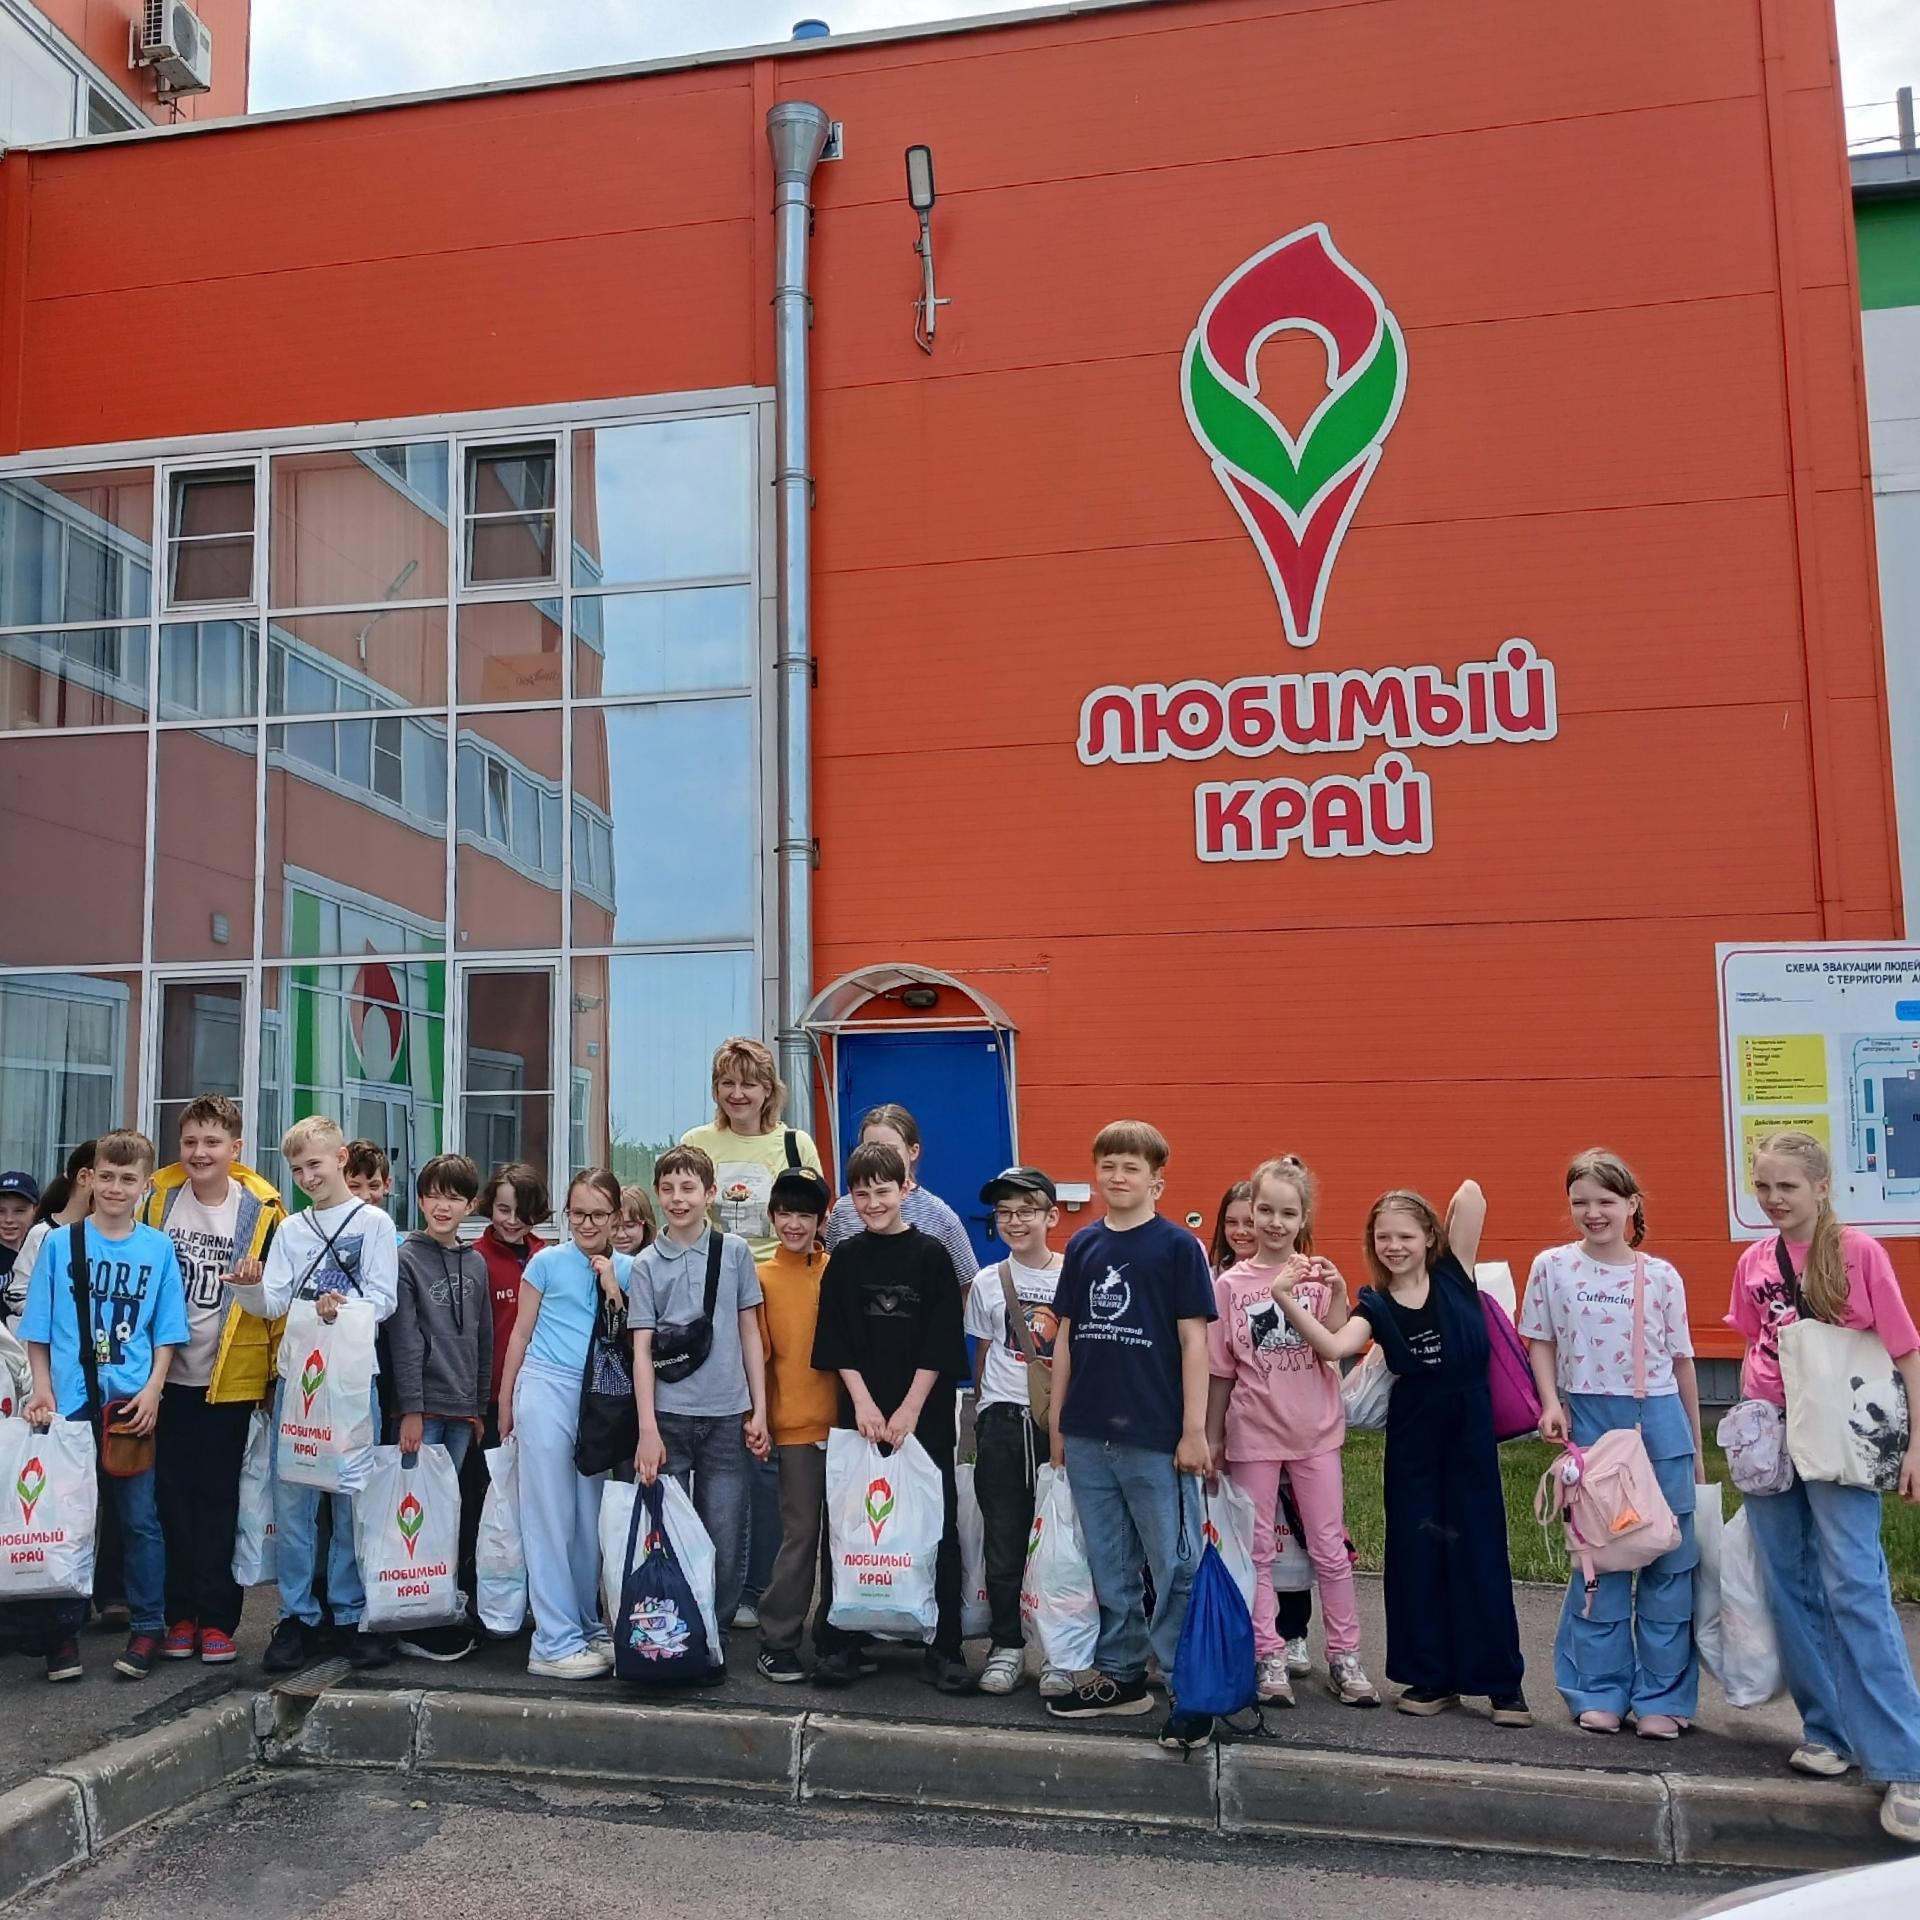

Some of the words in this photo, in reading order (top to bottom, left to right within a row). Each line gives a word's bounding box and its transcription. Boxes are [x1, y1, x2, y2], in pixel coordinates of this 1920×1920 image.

[1084, 645, 1549, 758] ЛЮБИМЫЙ
[1202, 757, 1425, 854] КРАЙ
[1785, 963, 1820, 973] СХЕМА
[1822, 962, 1882, 974] ЭВАКУАЦИИ
[1884, 959, 1920, 972] ЛЮДЕЙ
[1827, 975, 1835, 985] С
[1837, 974, 1902, 985] ТЕРРИТОРИИ
[168, 1227, 234, 1249] CALIFORNIA
[172, 1240, 233, 1261] ECREATION
[652, 1353, 690, 1369] Reebok
[281, 1423, 331, 1441] ЛЮБИМЫЙ
[294, 1442, 318, 1457] КРАЙ
[0, 1528, 64, 1546] ЮБИМЫЙ
[10, 1547, 44, 1563] КРАЙ
[843, 1552, 912, 1568] ЛЮБИМЫЙ
[379, 1561, 447, 1582] ЛЮБИМЫЙ
[859, 1570, 893, 1586] КРАЙ
[397, 1581, 430, 1597] КРАЙ
